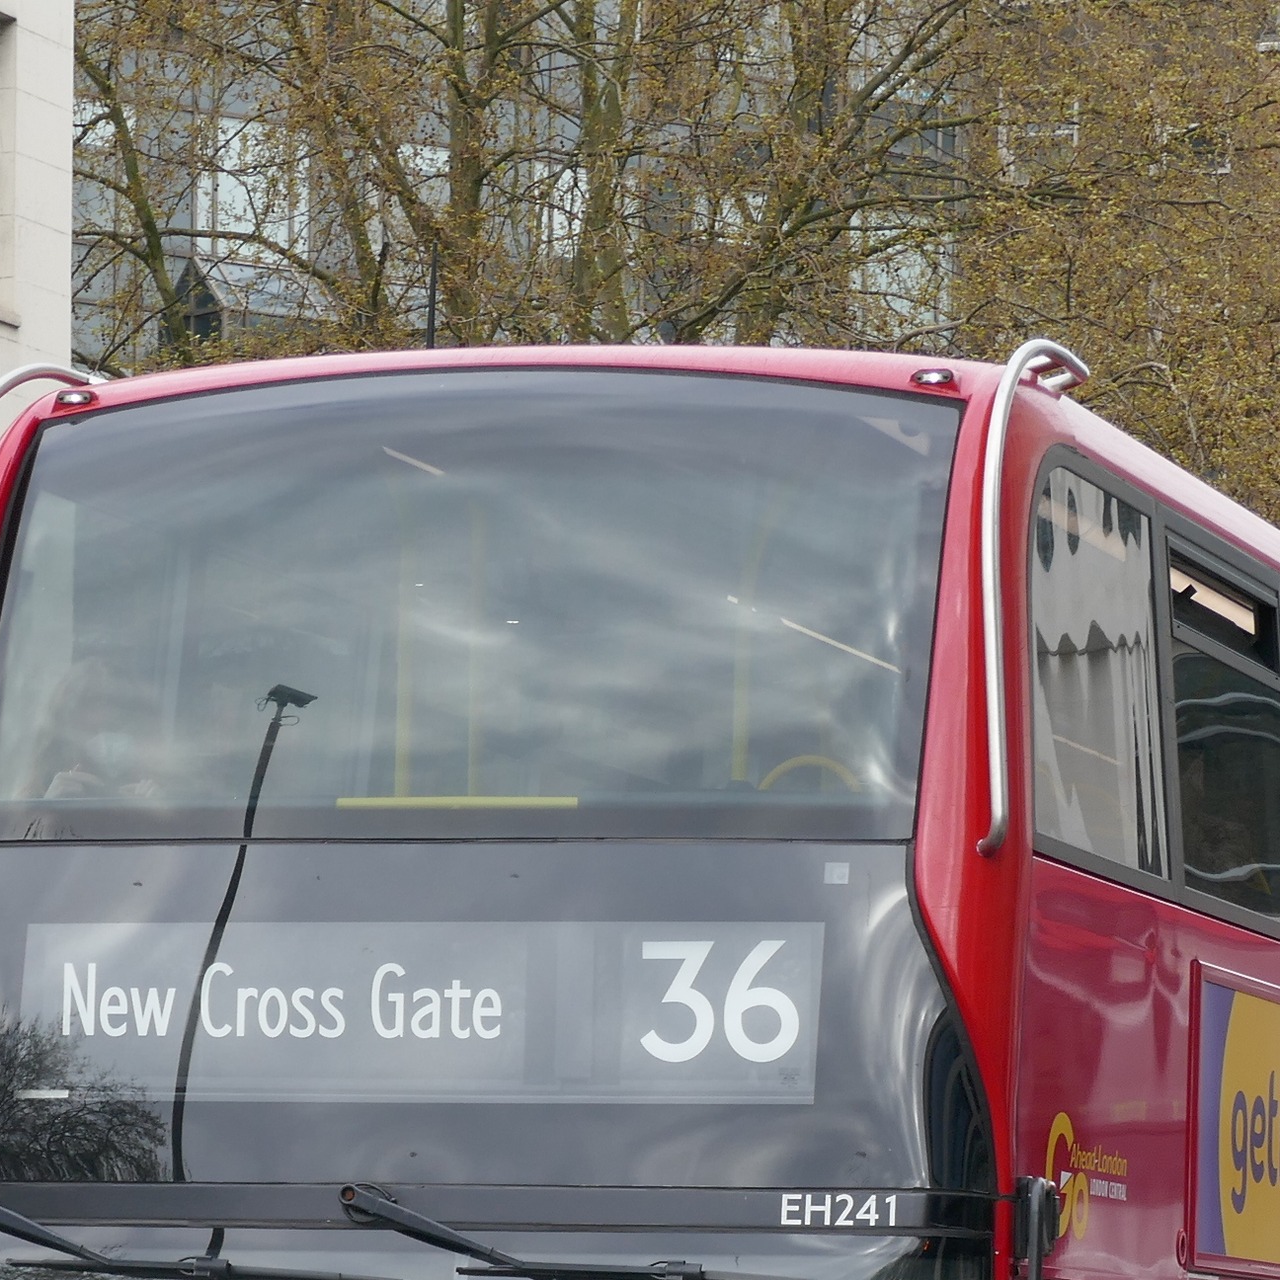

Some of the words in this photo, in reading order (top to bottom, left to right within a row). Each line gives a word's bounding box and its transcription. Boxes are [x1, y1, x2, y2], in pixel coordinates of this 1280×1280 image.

[62, 962, 177, 1037] New
[200, 962, 346, 1038] Cross
[371, 962, 503, 1040] Gate
[639, 940, 800, 1063] 36
[780, 1193, 898, 1227] EH241
